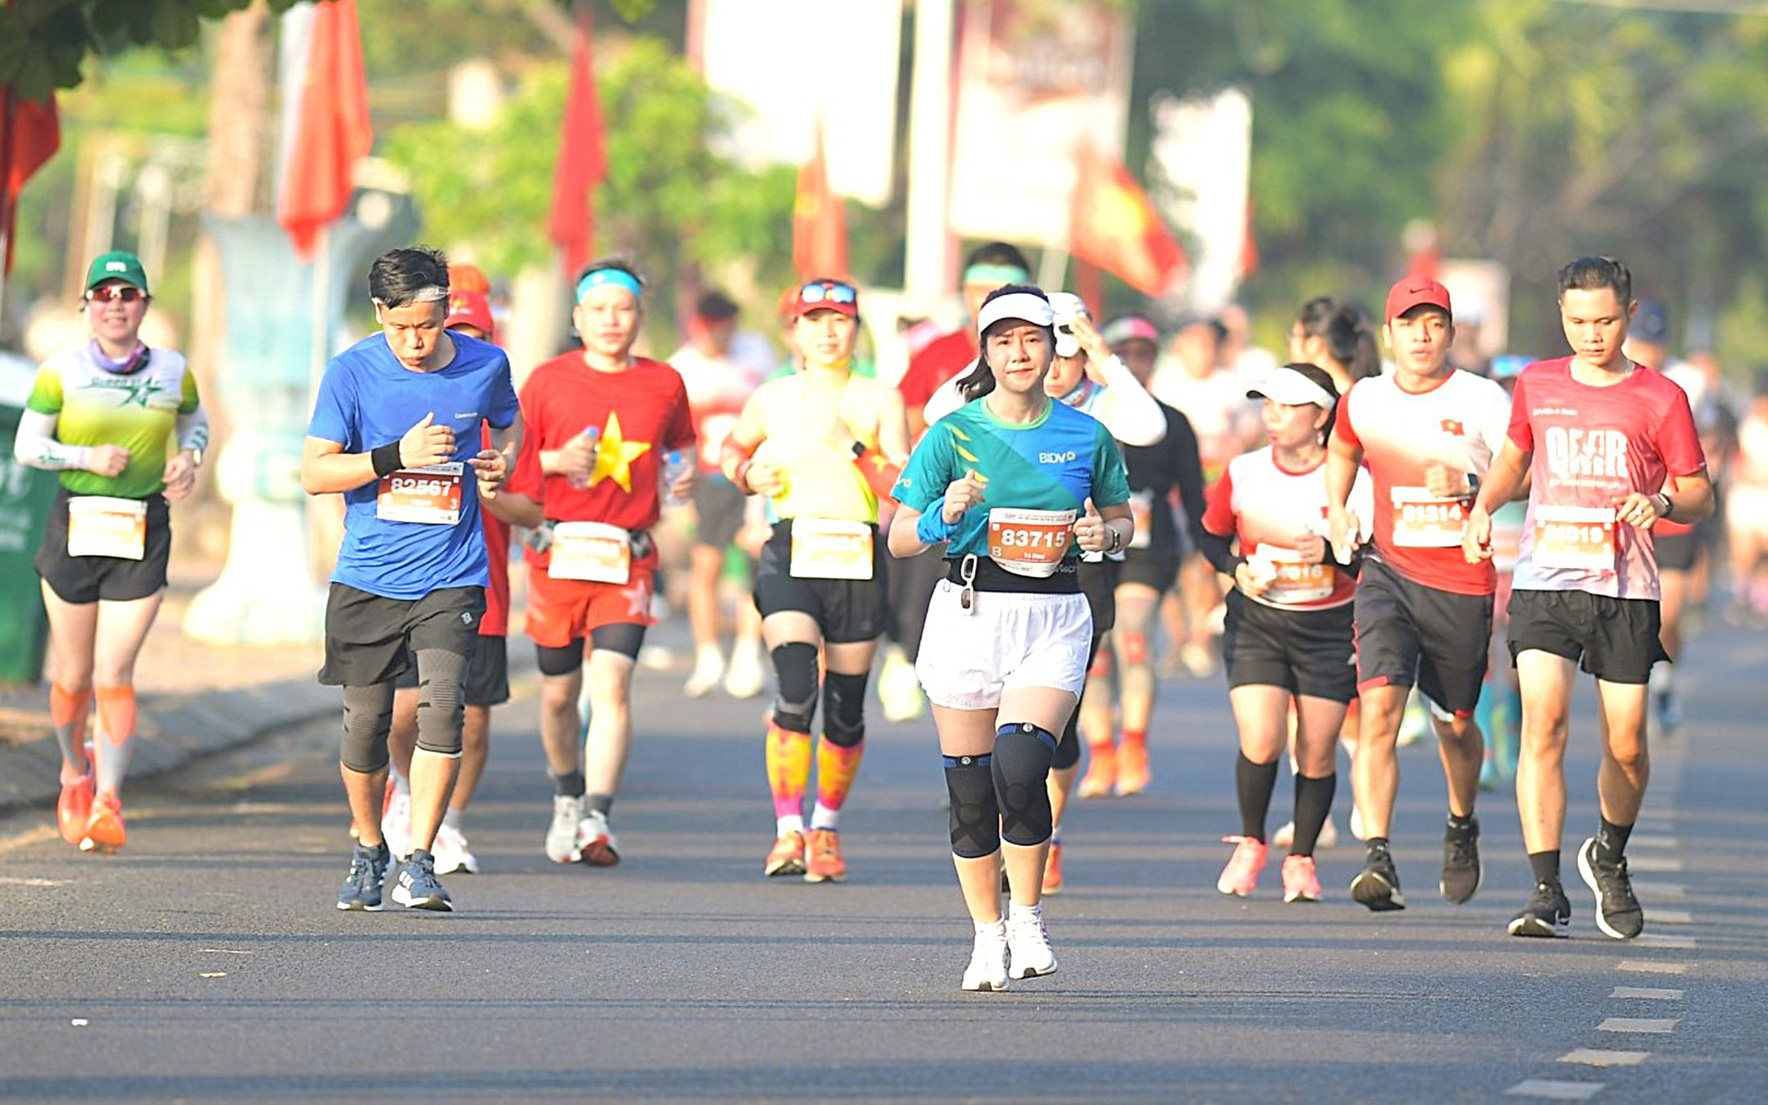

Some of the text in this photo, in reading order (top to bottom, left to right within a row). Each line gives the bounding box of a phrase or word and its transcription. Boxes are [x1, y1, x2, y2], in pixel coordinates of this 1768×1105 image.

[1039, 452, 1066, 463] BIDV
[390, 477, 452, 496] 82567
[1001, 529, 1066, 548] 83715
